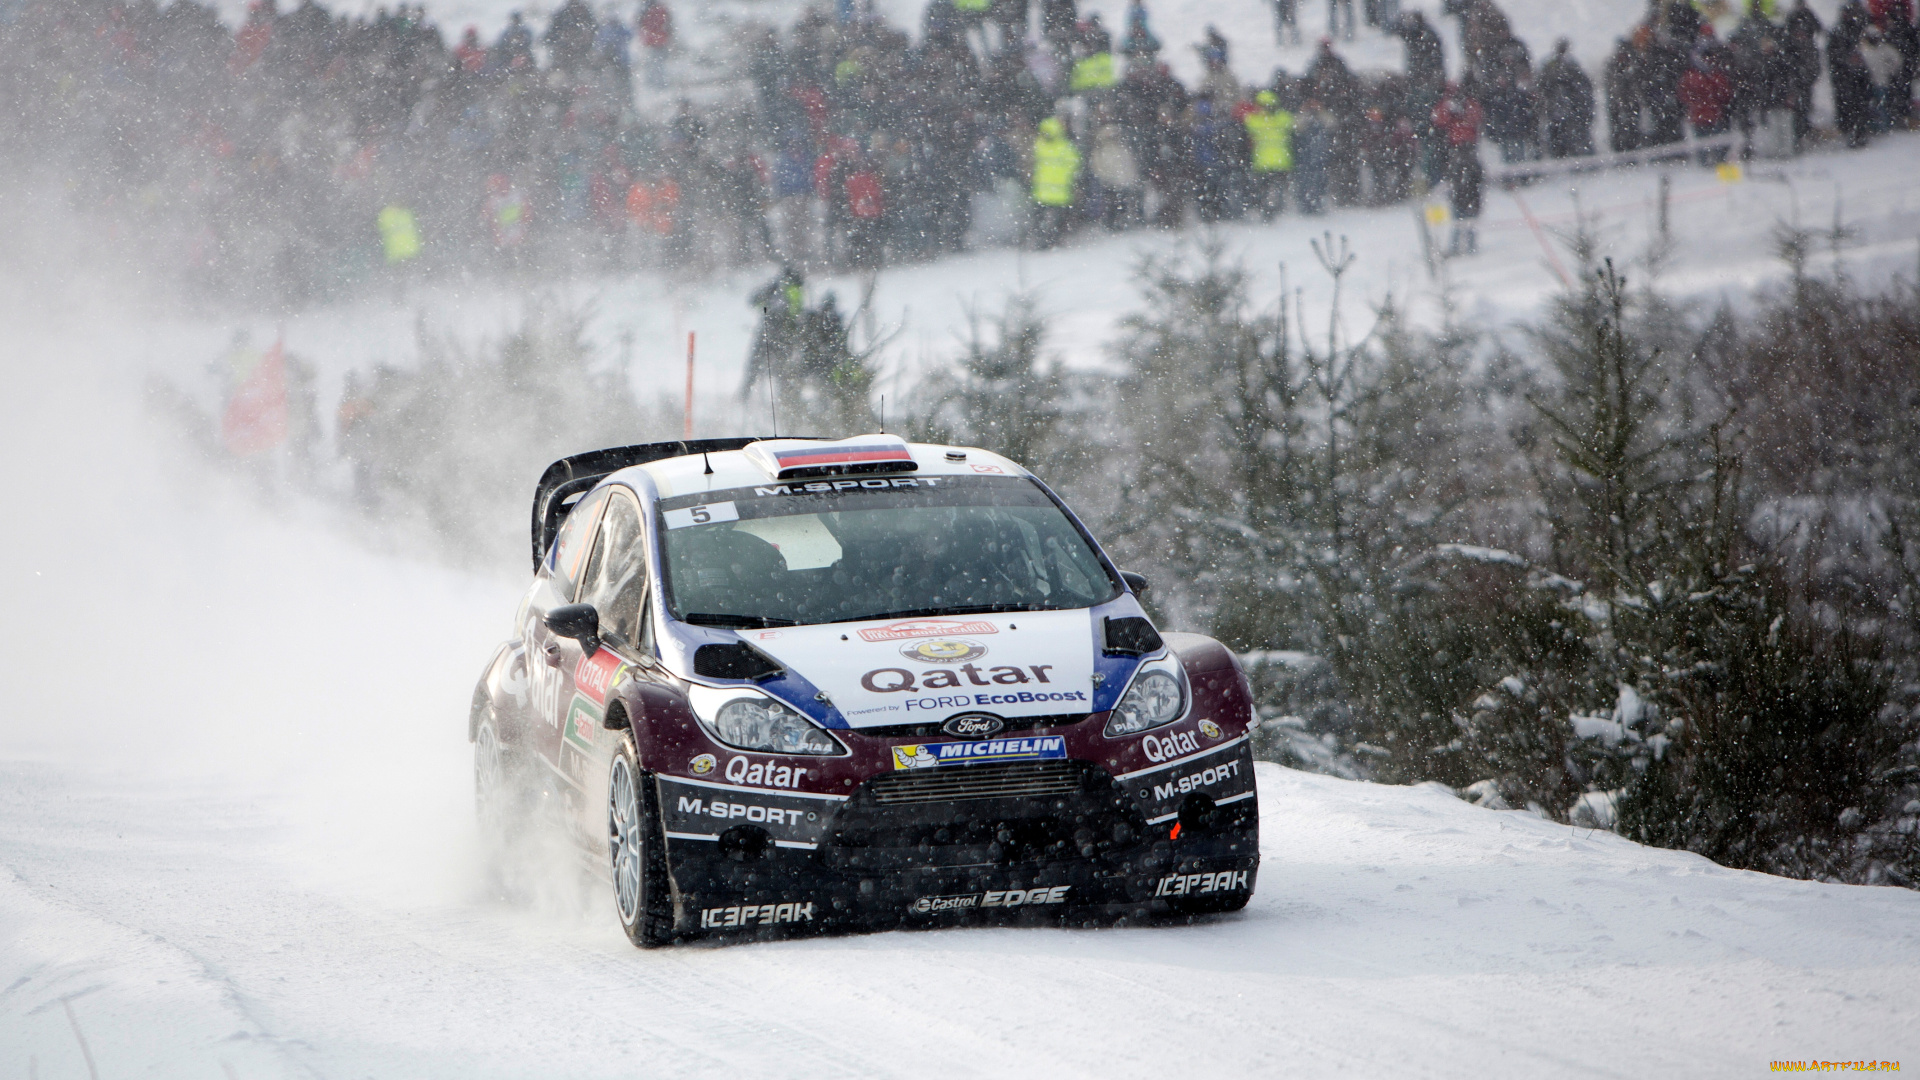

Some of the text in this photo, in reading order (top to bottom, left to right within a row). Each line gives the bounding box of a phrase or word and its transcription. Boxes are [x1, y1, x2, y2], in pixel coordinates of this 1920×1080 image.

[754, 477, 942, 497] M-SPORT
[690, 505, 711, 523] 5
[578, 657, 606, 695] TOTAL
[861, 663, 1053, 693] Qatar
[847, 690, 1088, 716] Powered by FORD EcoBoost
[957, 717, 991, 733] Ford
[1113, 722, 1142, 733] PIAA
[800, 742, 833, 752] PIAA
[939, 737, 1061, 759] MICHELIN
[1142, 729, 1200, 763] Qatar
[724, 755, 807, 789] Qatar
[1153, 759, 1239, 801] M-SPORT
[677, 796, 803, 826] M-SPORT
[930, 885, 1072, 911] Castrol EDGE
